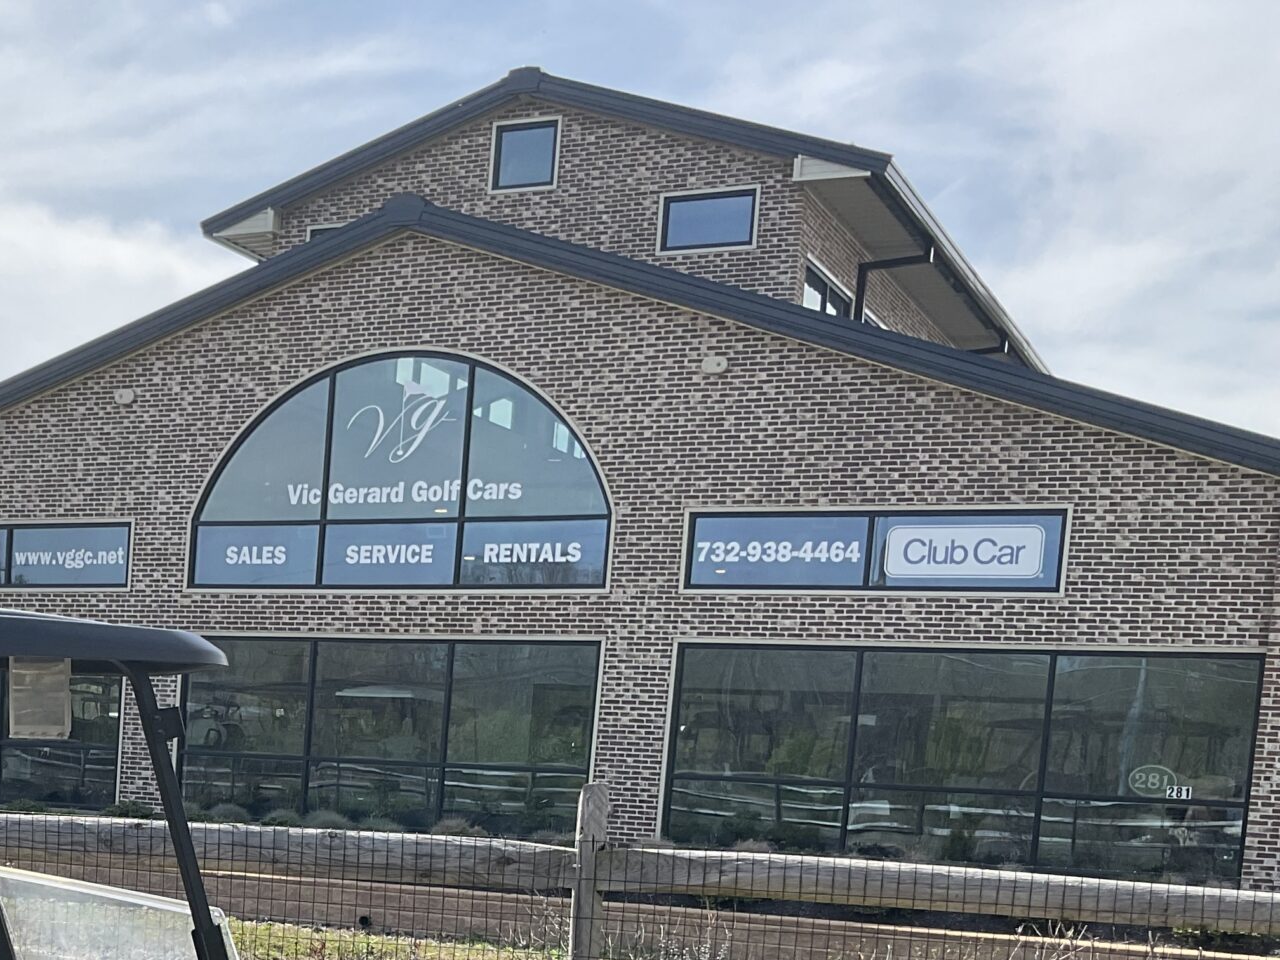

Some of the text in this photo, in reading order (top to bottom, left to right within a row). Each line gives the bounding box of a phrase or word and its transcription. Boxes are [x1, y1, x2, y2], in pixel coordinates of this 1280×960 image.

[288, 478, 522, 505] Vic Gerard Golf Cars
[14, 547, 124, 568] www.vggc.net
[225, 545, 286, 565] SALES
[345, 544, 433, 565] SERVICE
[483, 542, 582, 563] RENTALS
[696, 541, 861, 563] 732-938-4464
[903, 537, 1026, 564] Club Car
[1134, 773, 1168, 789] 281
[1167, 786, 1191, 798] 281
